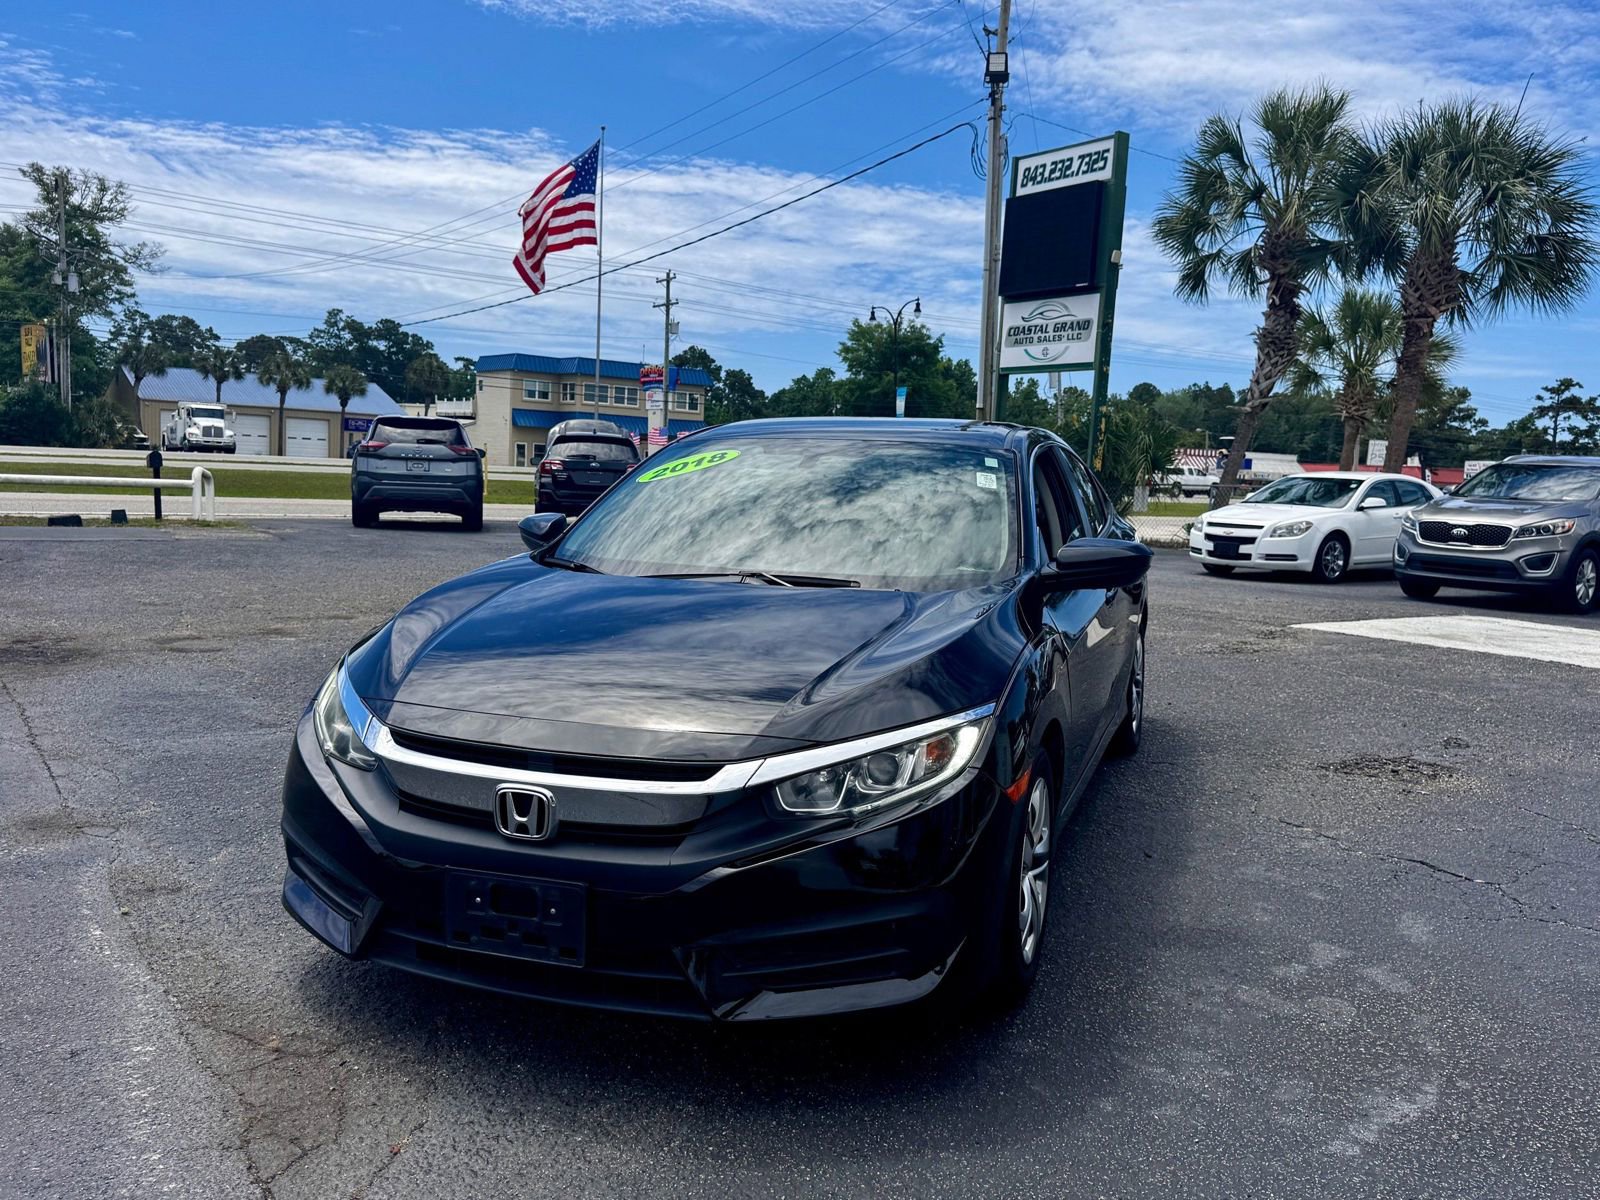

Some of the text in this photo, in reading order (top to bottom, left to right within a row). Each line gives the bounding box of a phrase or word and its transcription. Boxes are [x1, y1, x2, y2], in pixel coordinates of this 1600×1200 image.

[1020, 148, 1110, 188] 843.232.7325
[1007, 319, 1091, 337] COASTAL GRAND
[1013, 336, 1034, 345] AUTO
[1066, 332, 1082, 341] LLC
[648, 452, 729, 480] 2018
